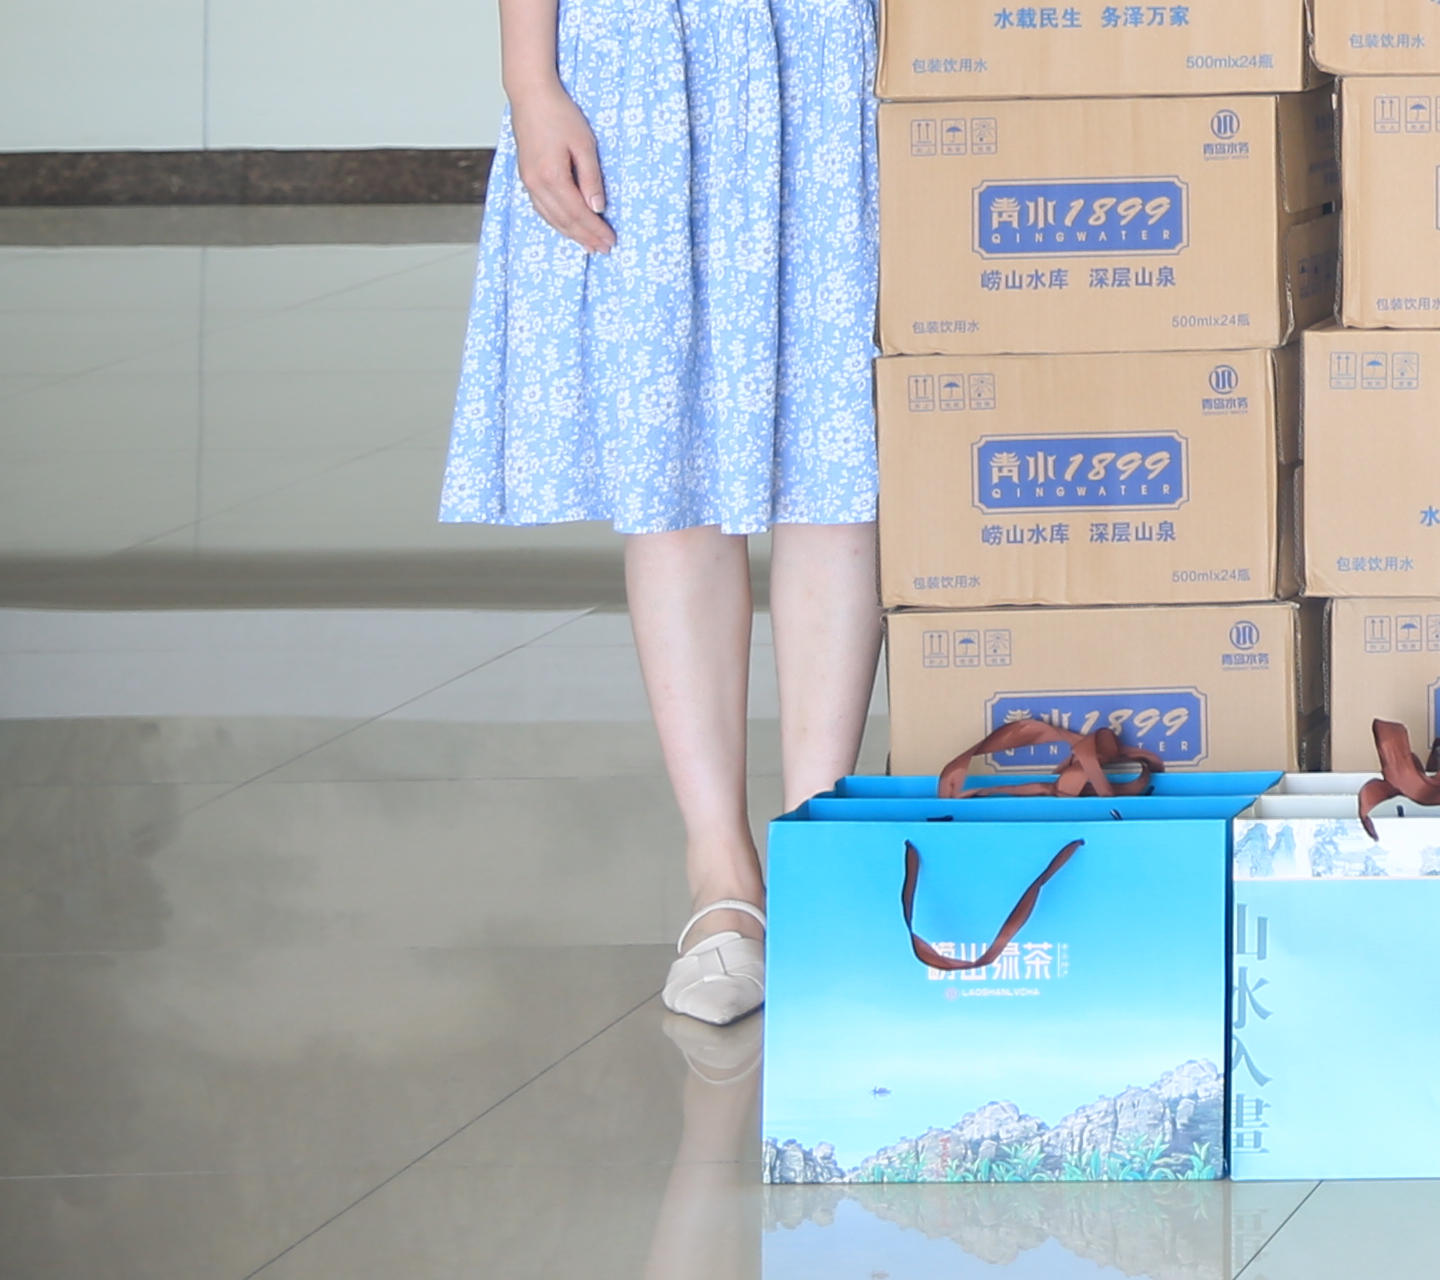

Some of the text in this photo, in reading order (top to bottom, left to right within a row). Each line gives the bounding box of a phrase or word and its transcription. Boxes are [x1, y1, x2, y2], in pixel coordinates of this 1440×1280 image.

[993, 5, 1191, 30] 水载民生 务泽万家
[912, 57, 989, 74] 包装饮用水
[991, 229, 1171, 244] QINGWATER
[980, 266, 1176, 291] 崂山水库 深层山泉
[981, 521, 1176, 545] 崂山水库 深层山泉
[1335, 556, 1414, 572] 包装饮用水
